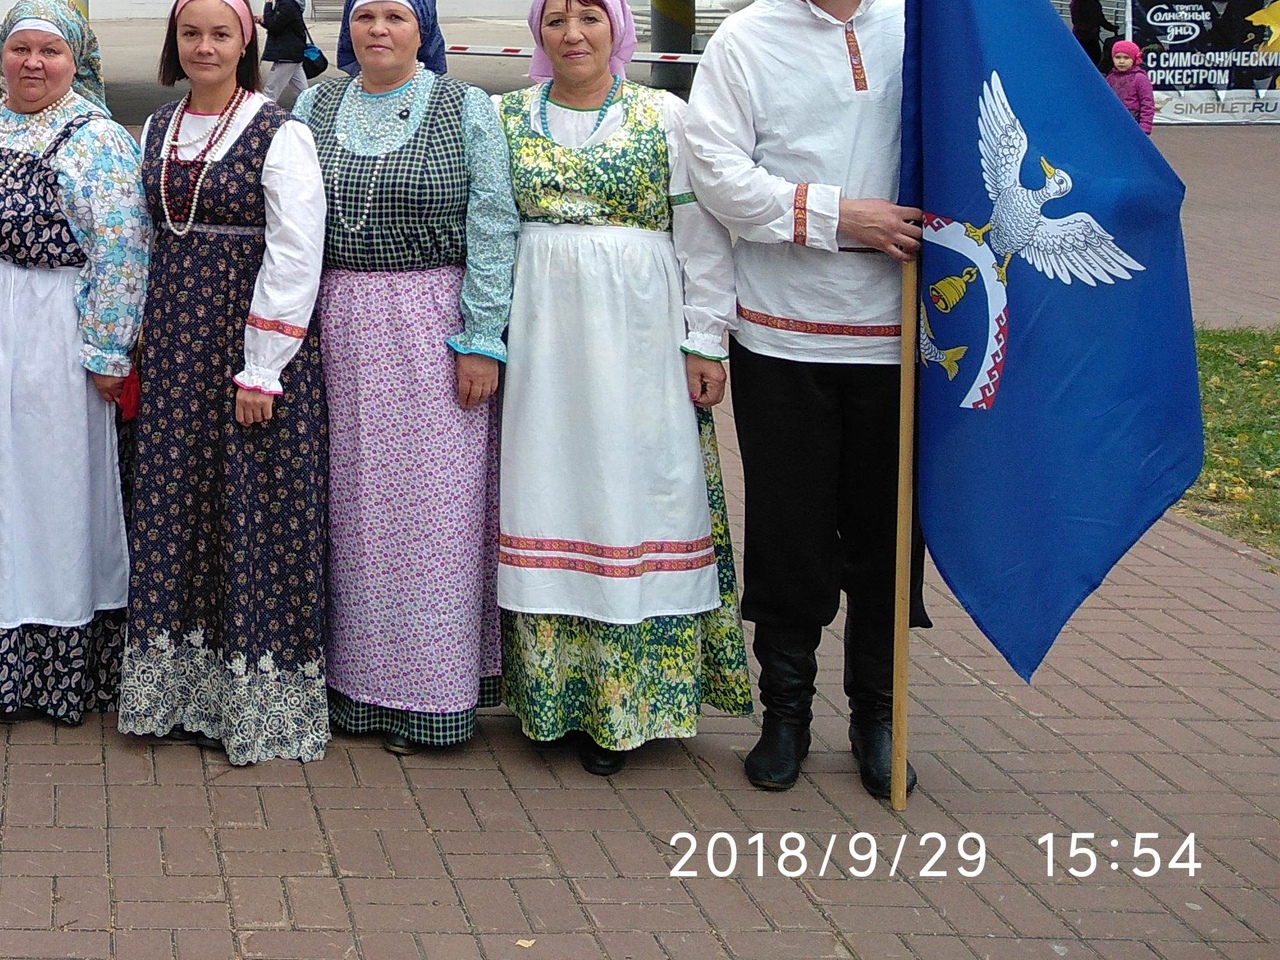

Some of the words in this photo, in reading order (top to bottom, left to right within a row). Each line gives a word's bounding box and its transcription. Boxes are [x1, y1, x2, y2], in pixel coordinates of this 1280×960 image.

[1147, 52, 1157, 68] С
[1148, 69, 1230, 85] ОРКЕСТРОМ
[1173, 102, 1278, 115] SIMBILET.RU
